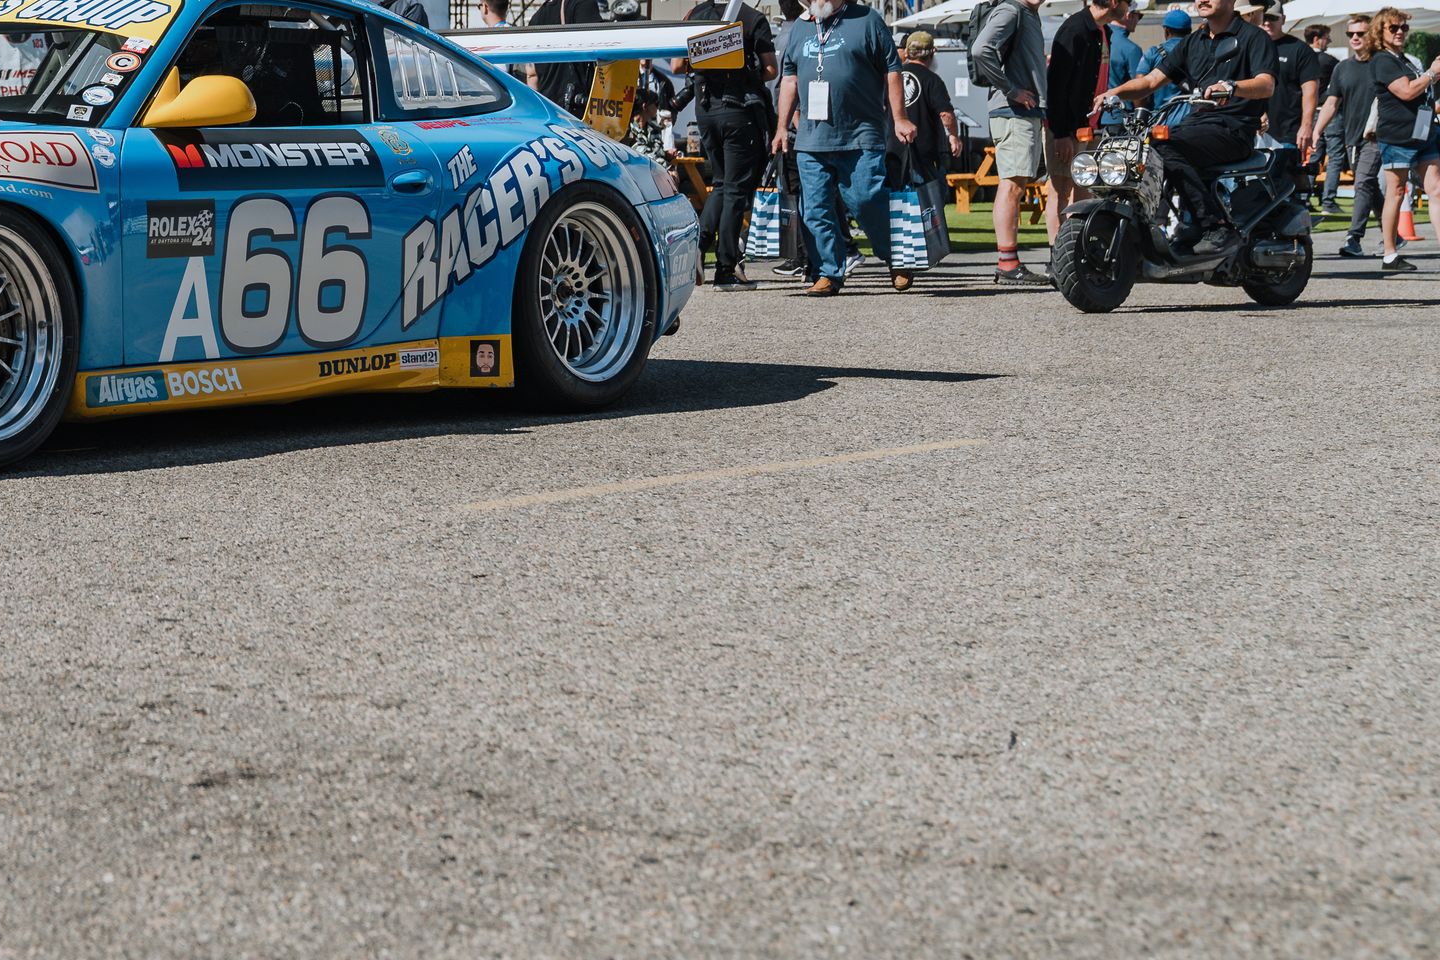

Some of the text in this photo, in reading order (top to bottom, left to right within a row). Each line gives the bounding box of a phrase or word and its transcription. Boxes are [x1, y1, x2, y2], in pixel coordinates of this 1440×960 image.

[702, 31, 741, 48] Wine Country
[703, 39, 742, 55] Motor Sports
[589, 97, 624, 119] FIKSE
[447, 144, 478, 190] THE
[149, 216, 213, 247] ROLEX 24
[401, 136, 587, 331] RACER'S
[319, 352, 397, 378] DUNLOP
[401, 350, 438, 365] stand21
[98, 375, 158, 404] Airgas
[168, 367, 242, 397] BOSCH
